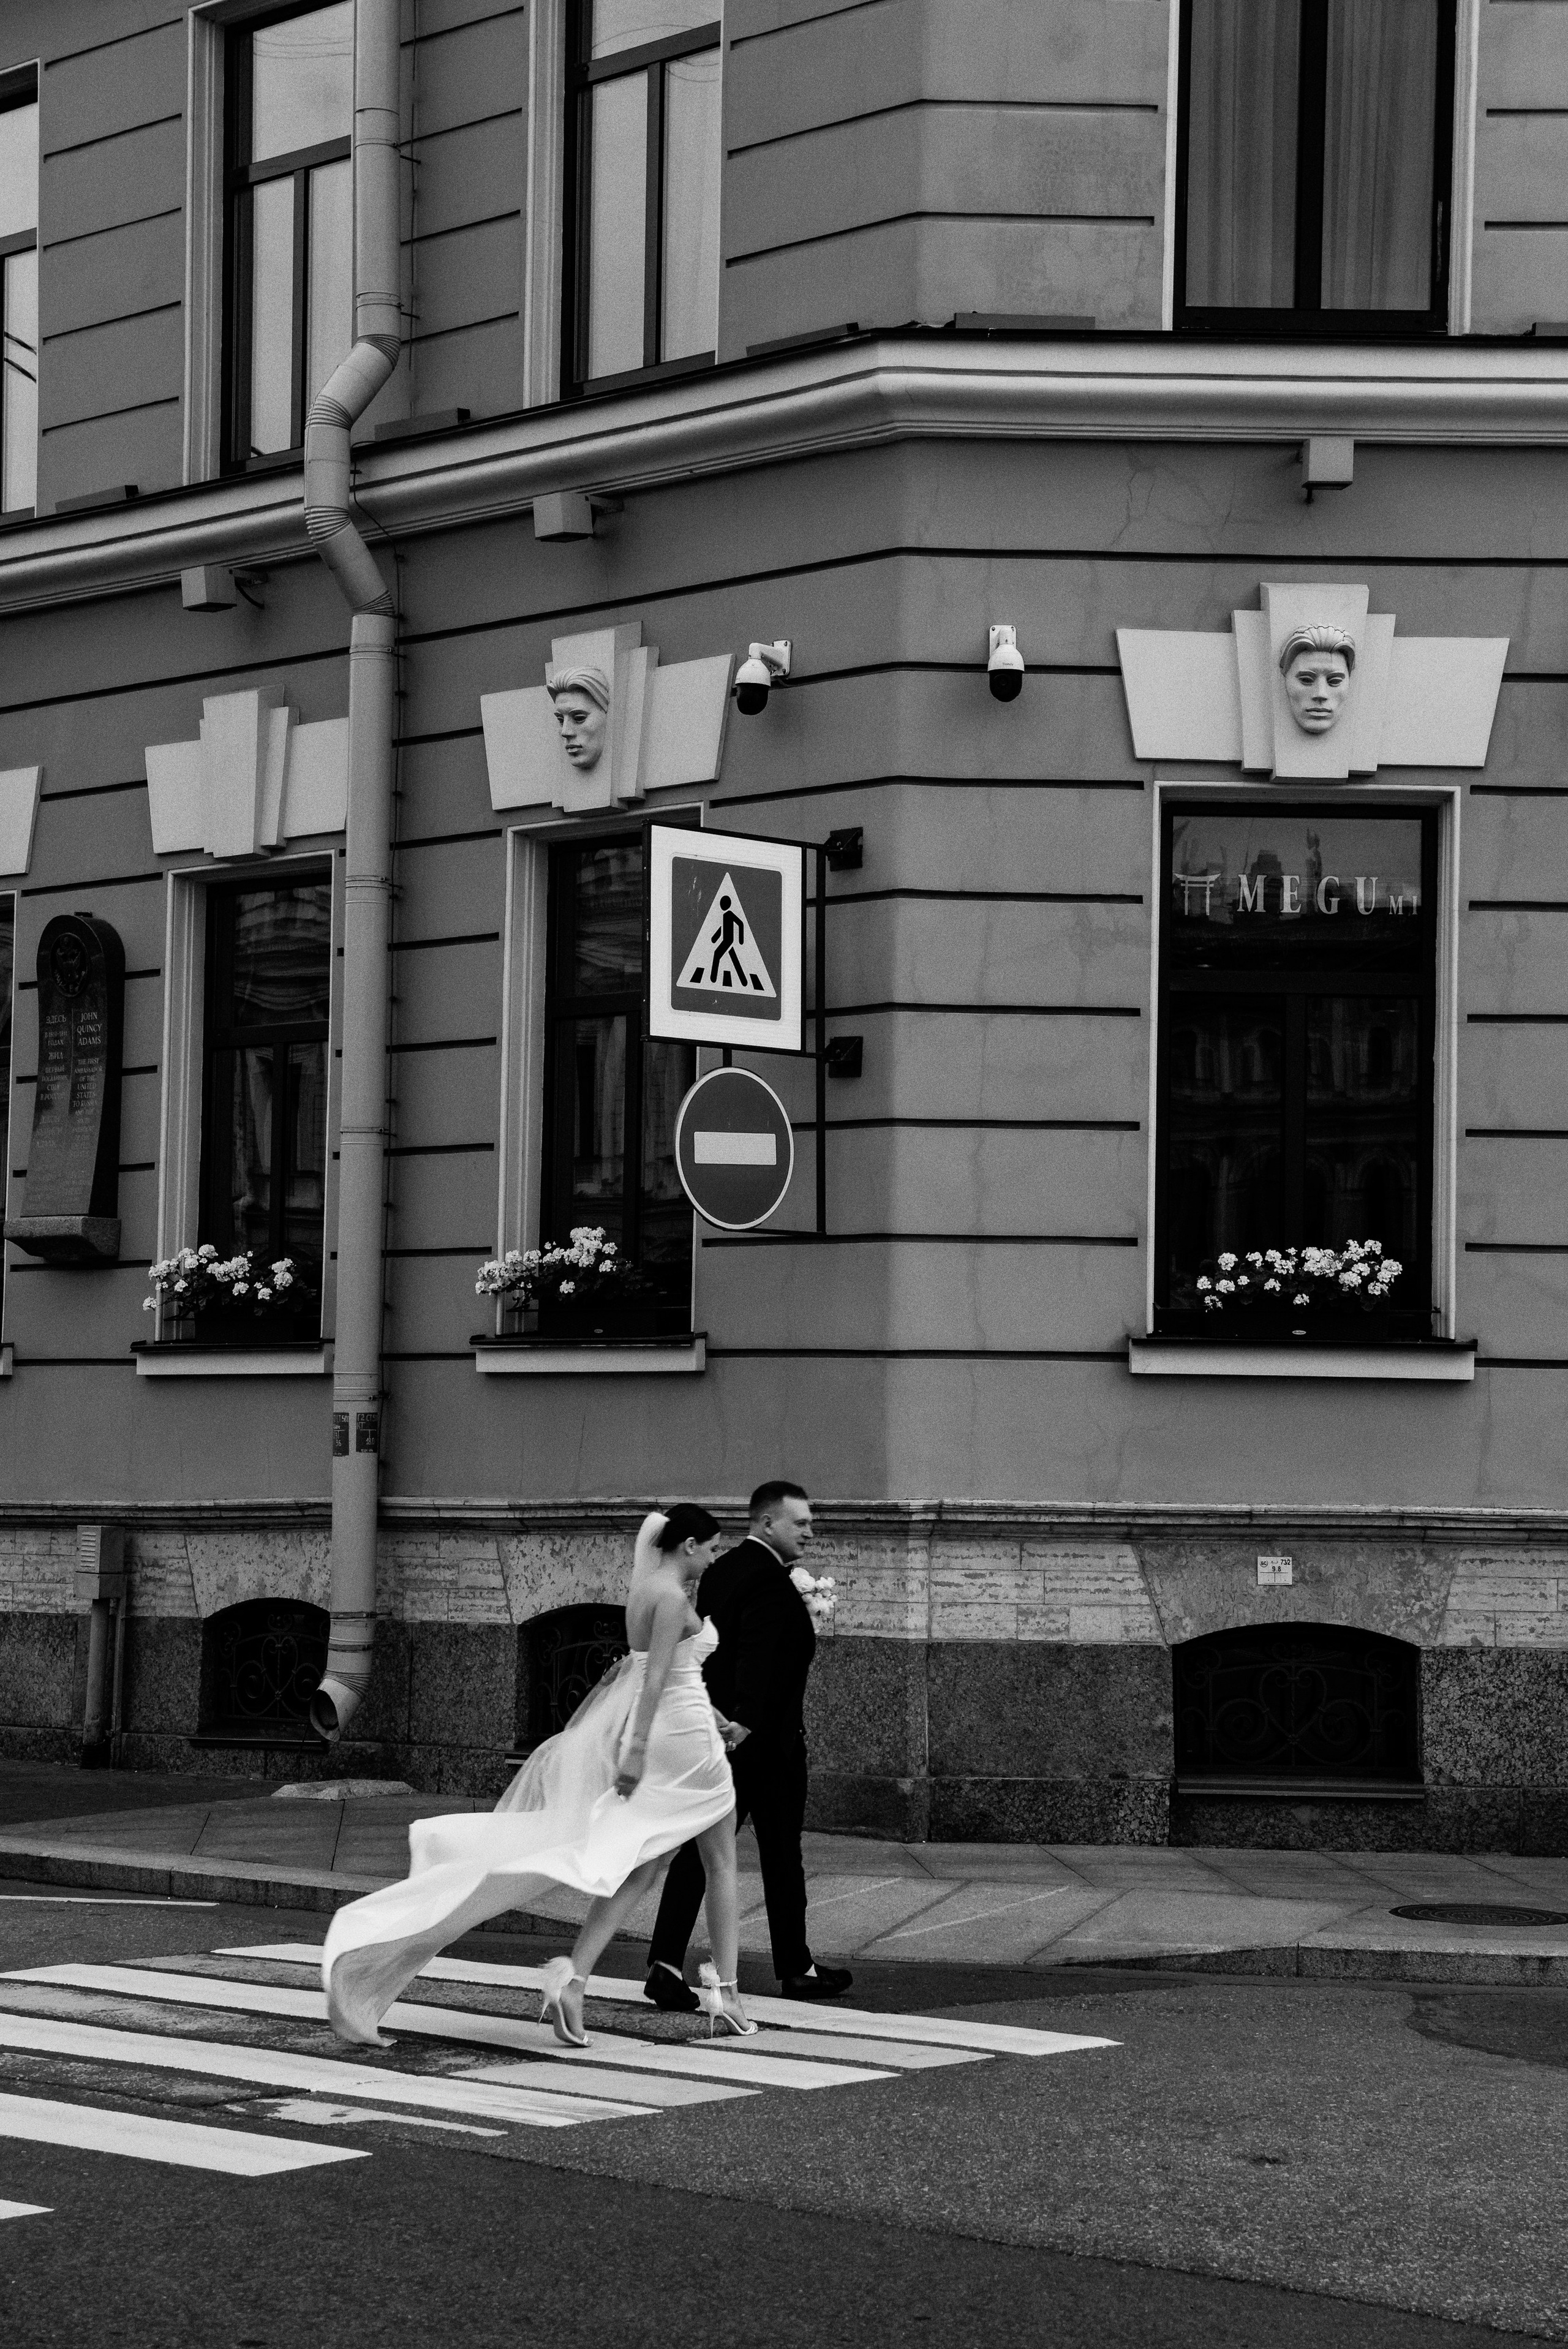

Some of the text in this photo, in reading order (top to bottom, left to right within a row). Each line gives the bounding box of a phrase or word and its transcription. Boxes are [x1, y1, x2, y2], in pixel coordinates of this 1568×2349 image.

[46, 1014, 67, 1024] ЗДЕСЬ
[80, 1012, 97, 1022] JOHN
[77, 1024, 102, 1035] QUINCY
[78, 1036, 101, 1046] ADAMS
[48, 1052, 63, 1060] ЖИЛ
